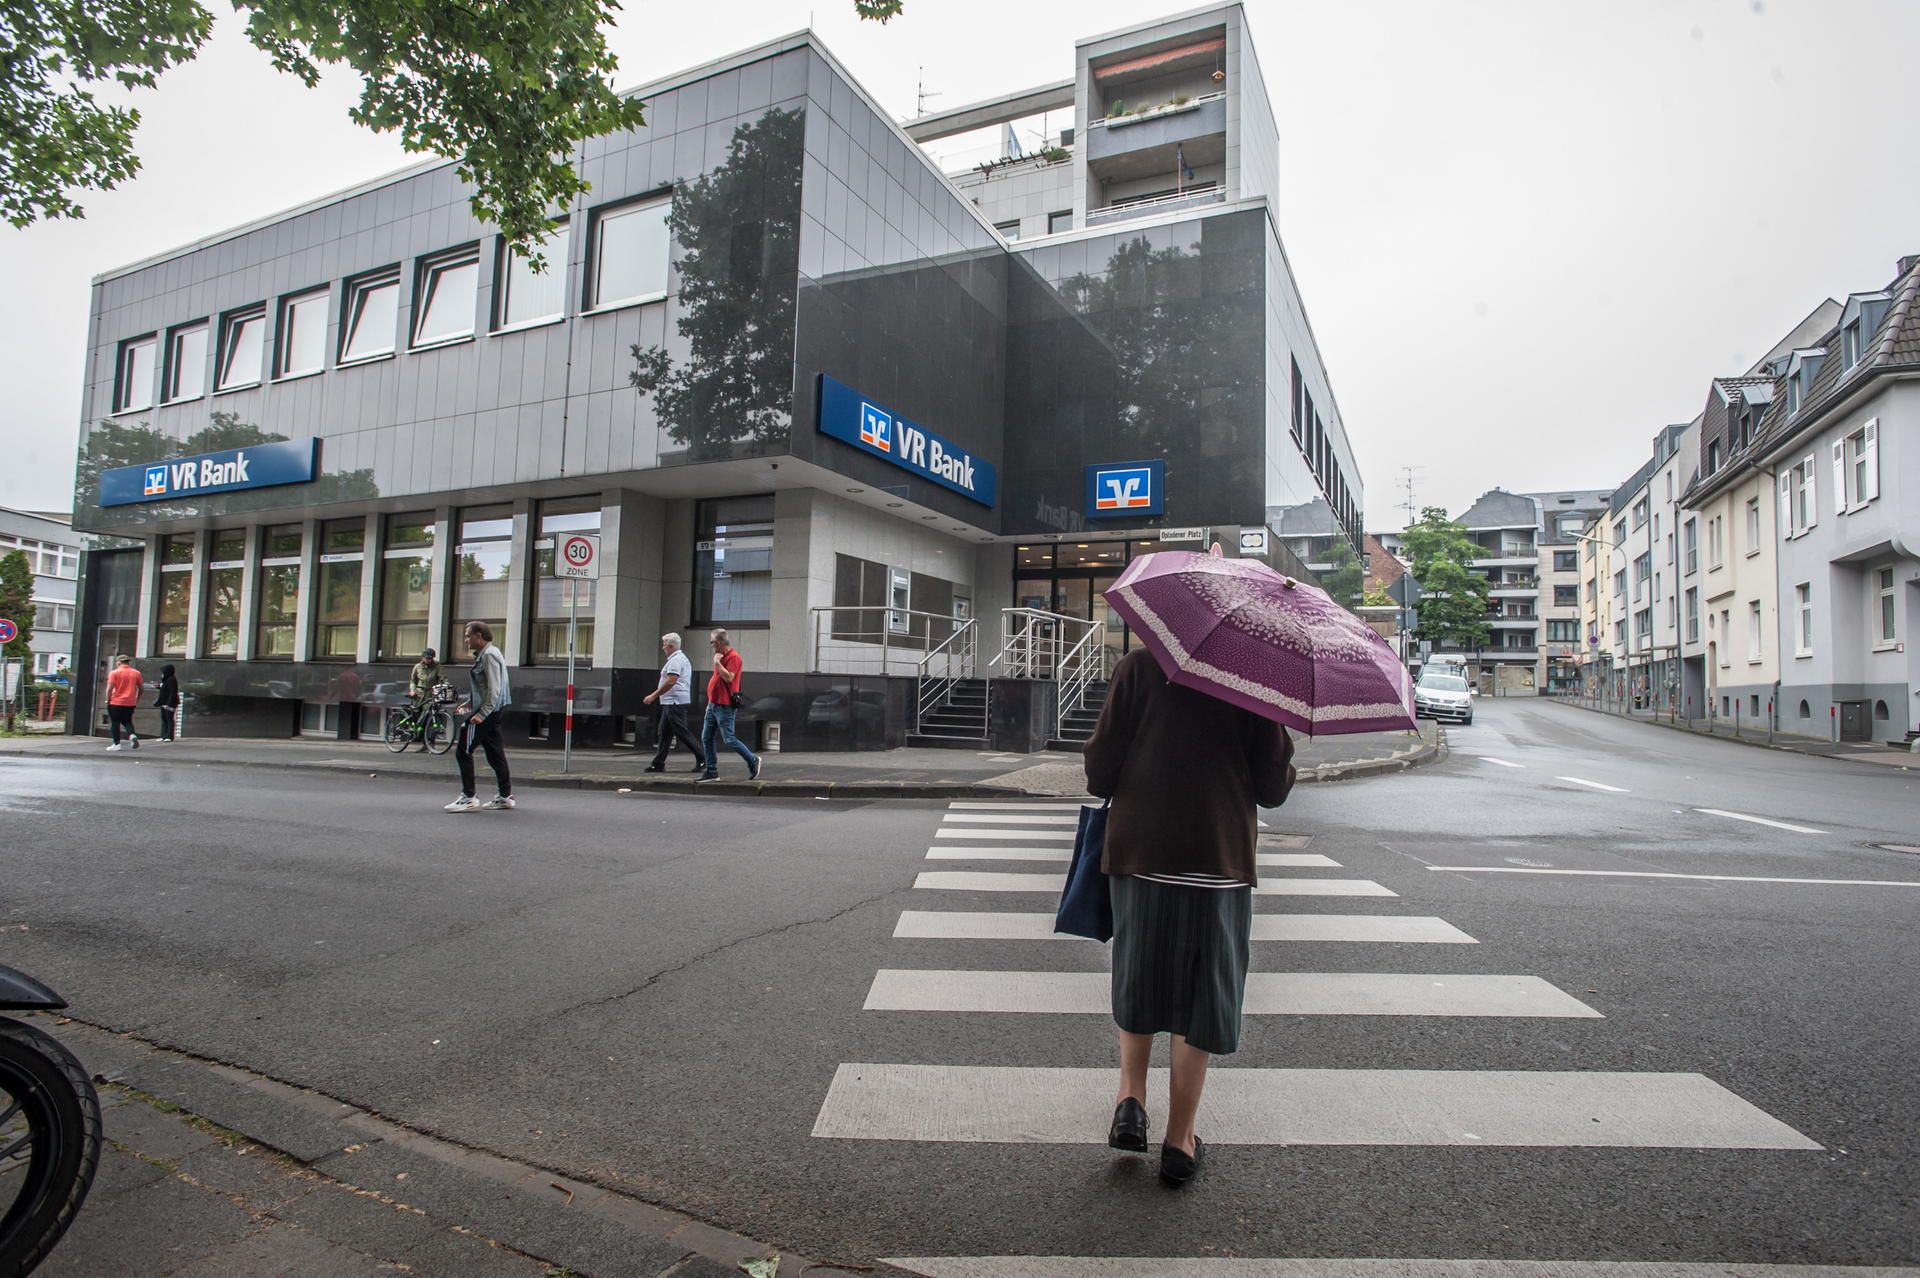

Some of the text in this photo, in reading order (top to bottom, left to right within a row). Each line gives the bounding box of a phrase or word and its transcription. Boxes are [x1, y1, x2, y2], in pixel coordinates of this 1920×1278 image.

[896, 421, 975, 491] VR Bank
[171, 452, 250, 491] VR Bank
[1187, 530, 1201, 538] Platz
[569, 544, 587, 559] 30
[566, 567, 588, 577] ZONE
